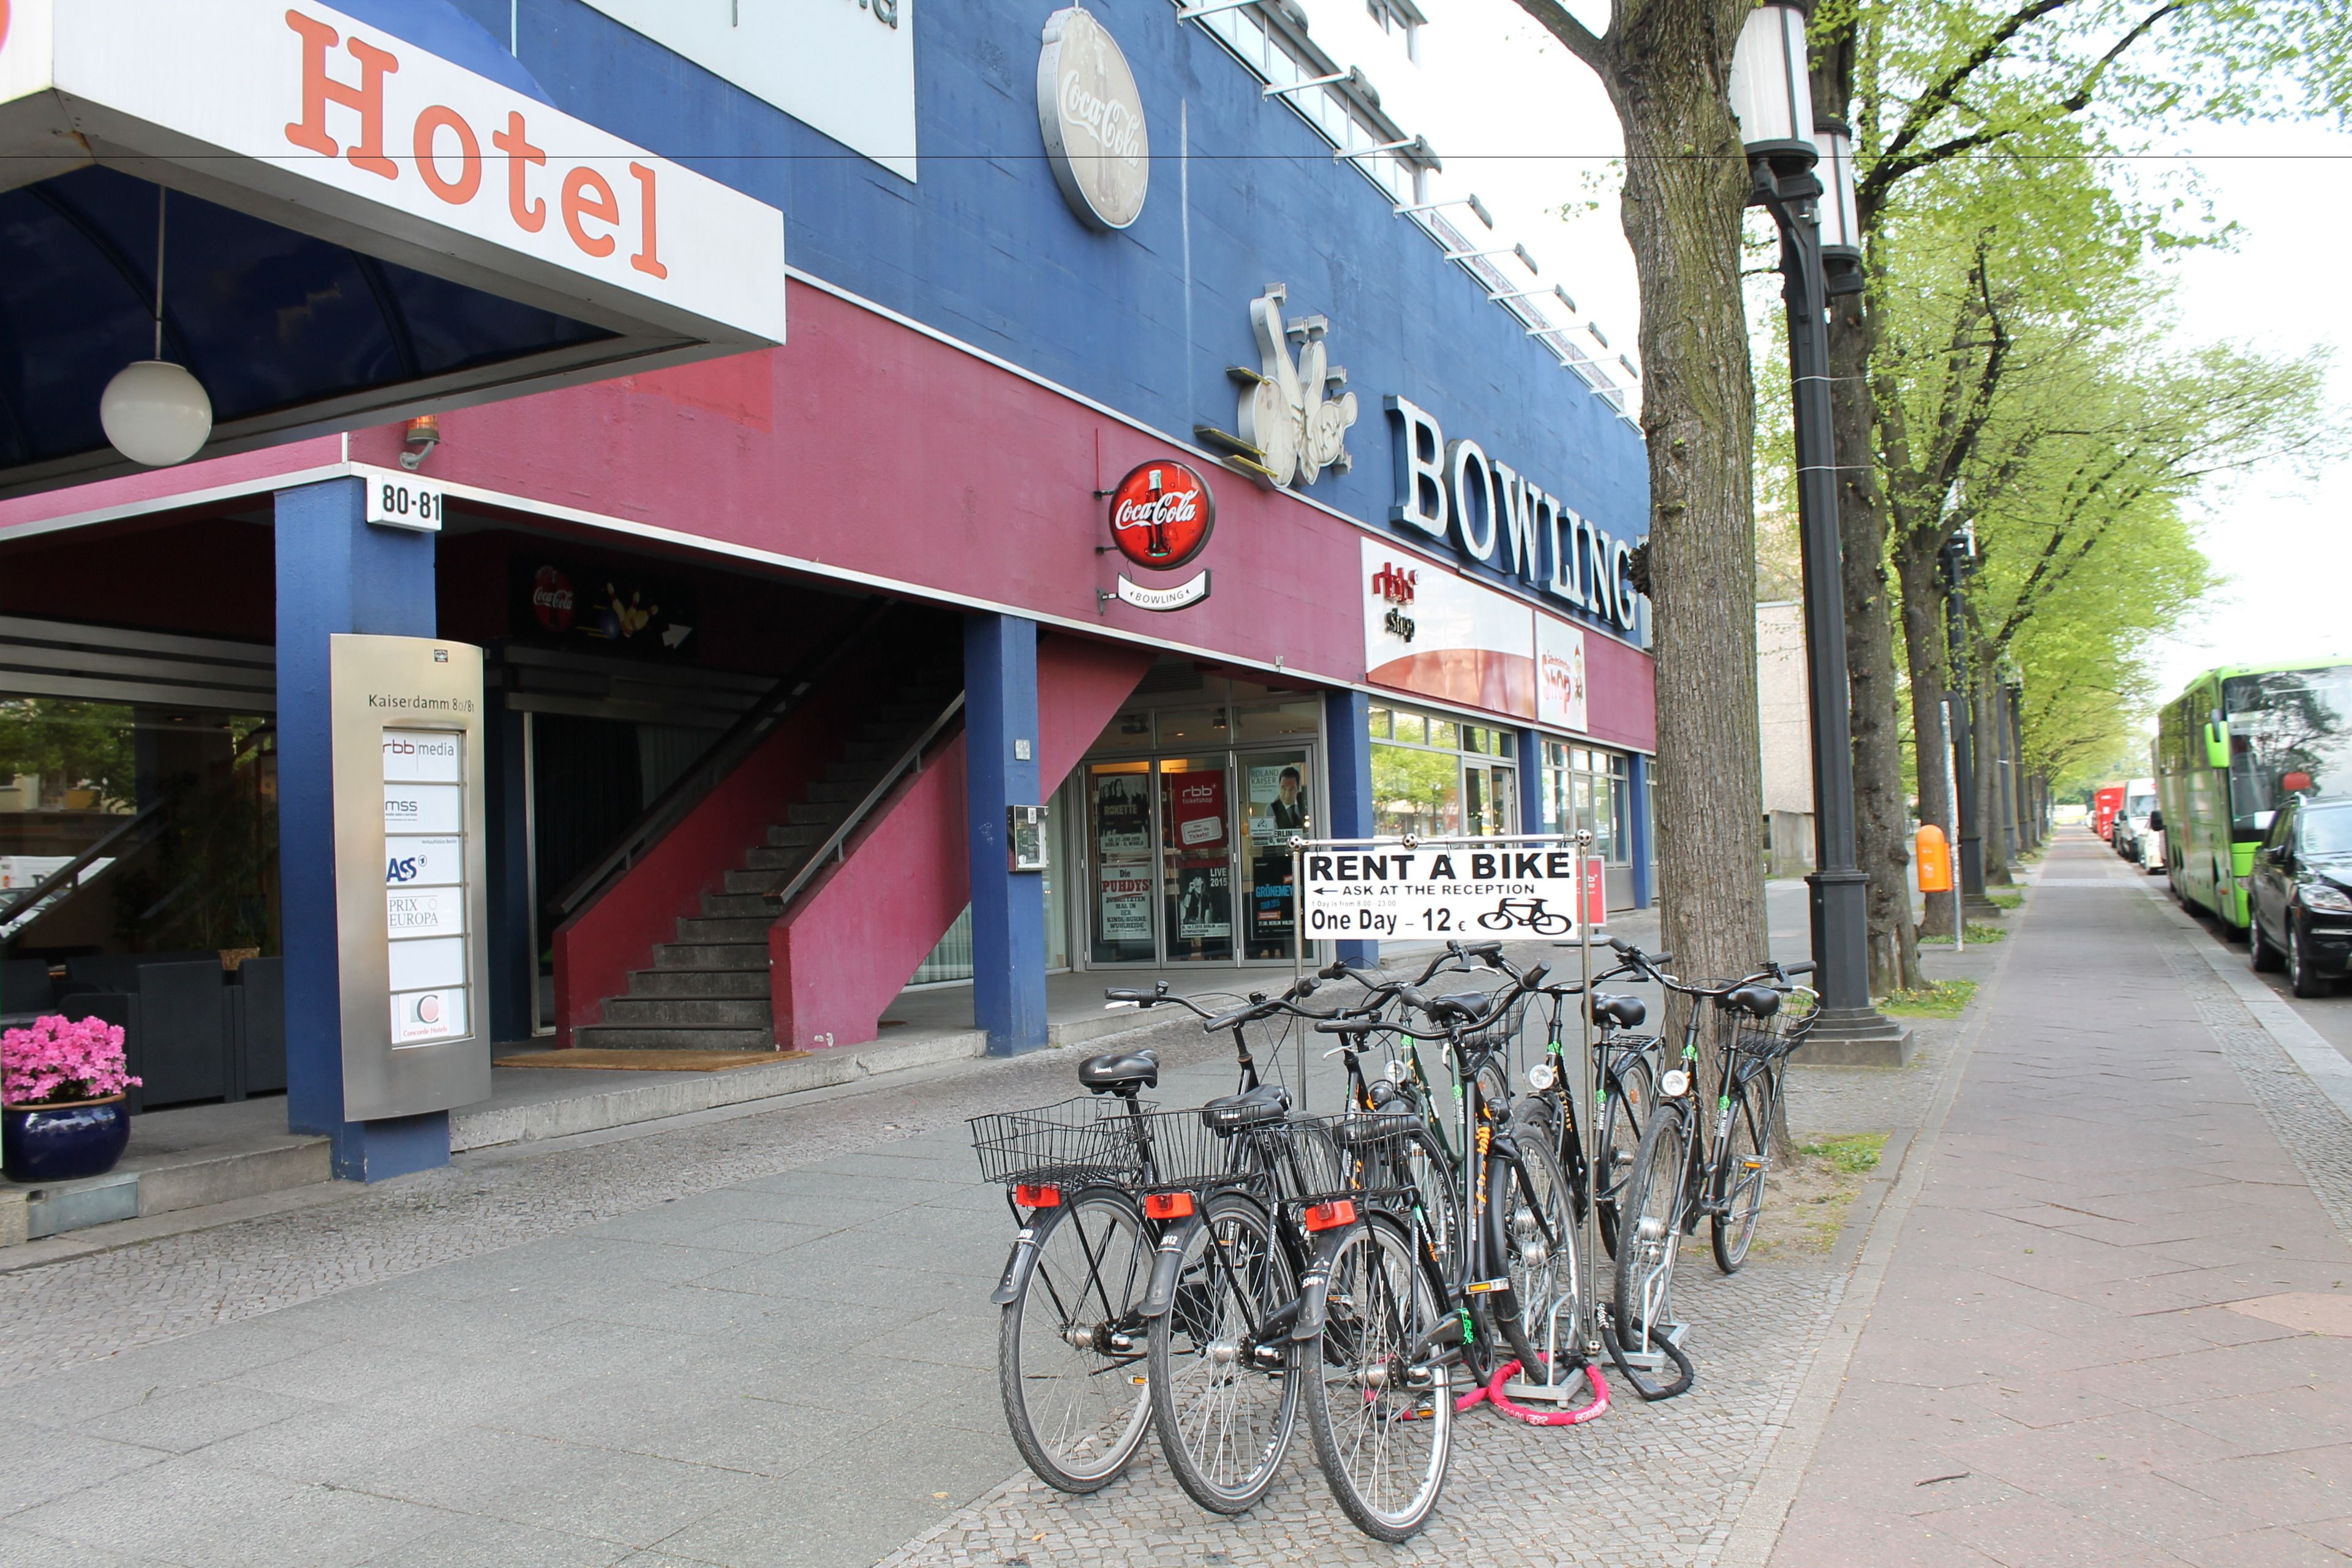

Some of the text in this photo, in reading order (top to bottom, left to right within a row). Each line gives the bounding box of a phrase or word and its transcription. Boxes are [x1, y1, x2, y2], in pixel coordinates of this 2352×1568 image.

[1060, 69, 1140, 168] Coca-Cola
[284, 8, 668, 281] Hotel
[382, 483, 440, 521] 80-81
[1115, 489, 1199, 530] Coca-Cola
[1384, 394, 1636, 631] BOWLING
[534, 586, 573, 610] Coca-Cola
[1135, 590, 1185, 604] BOWLING
[368, 694, 474, 712] Kaiserdamm 80/81
[383, 739, 454, 756] rbb media
[1251, 769, 1279, 777] ROLAND
[1183, 785, 1212, 797] rbb
[385, 801, 418, 812] mss
[1104, 804, 1137, 815] ROXETTE
[1120, 869, 1131, 878] Die
[1210, 868, 1227, 877] LIVE
[1310, 852, 1570, 881] RENT A BIKE
[1102, 878, 1150, 893] PUHDYS
[1210, 877, 1228, 887] 2015
[1343, 884, 1535, 895] ASK AT THE RECEPTION
[1256, 884, 1294, 897] GRÖNEMEY
[389, 899, 418, 912] PRIX
[390, 912, 439, 927] EUROPA
[1311, 908, 1351, 929] One
[1360, 909, 1397, 935] Day
[1422, 908, 1451, 931] 12
[1458, 921, 1466, 932] €
[403, 1025, 448, 1037] Concorde Hotels
[1719, 1109, 1729, 1137] BERLIN
